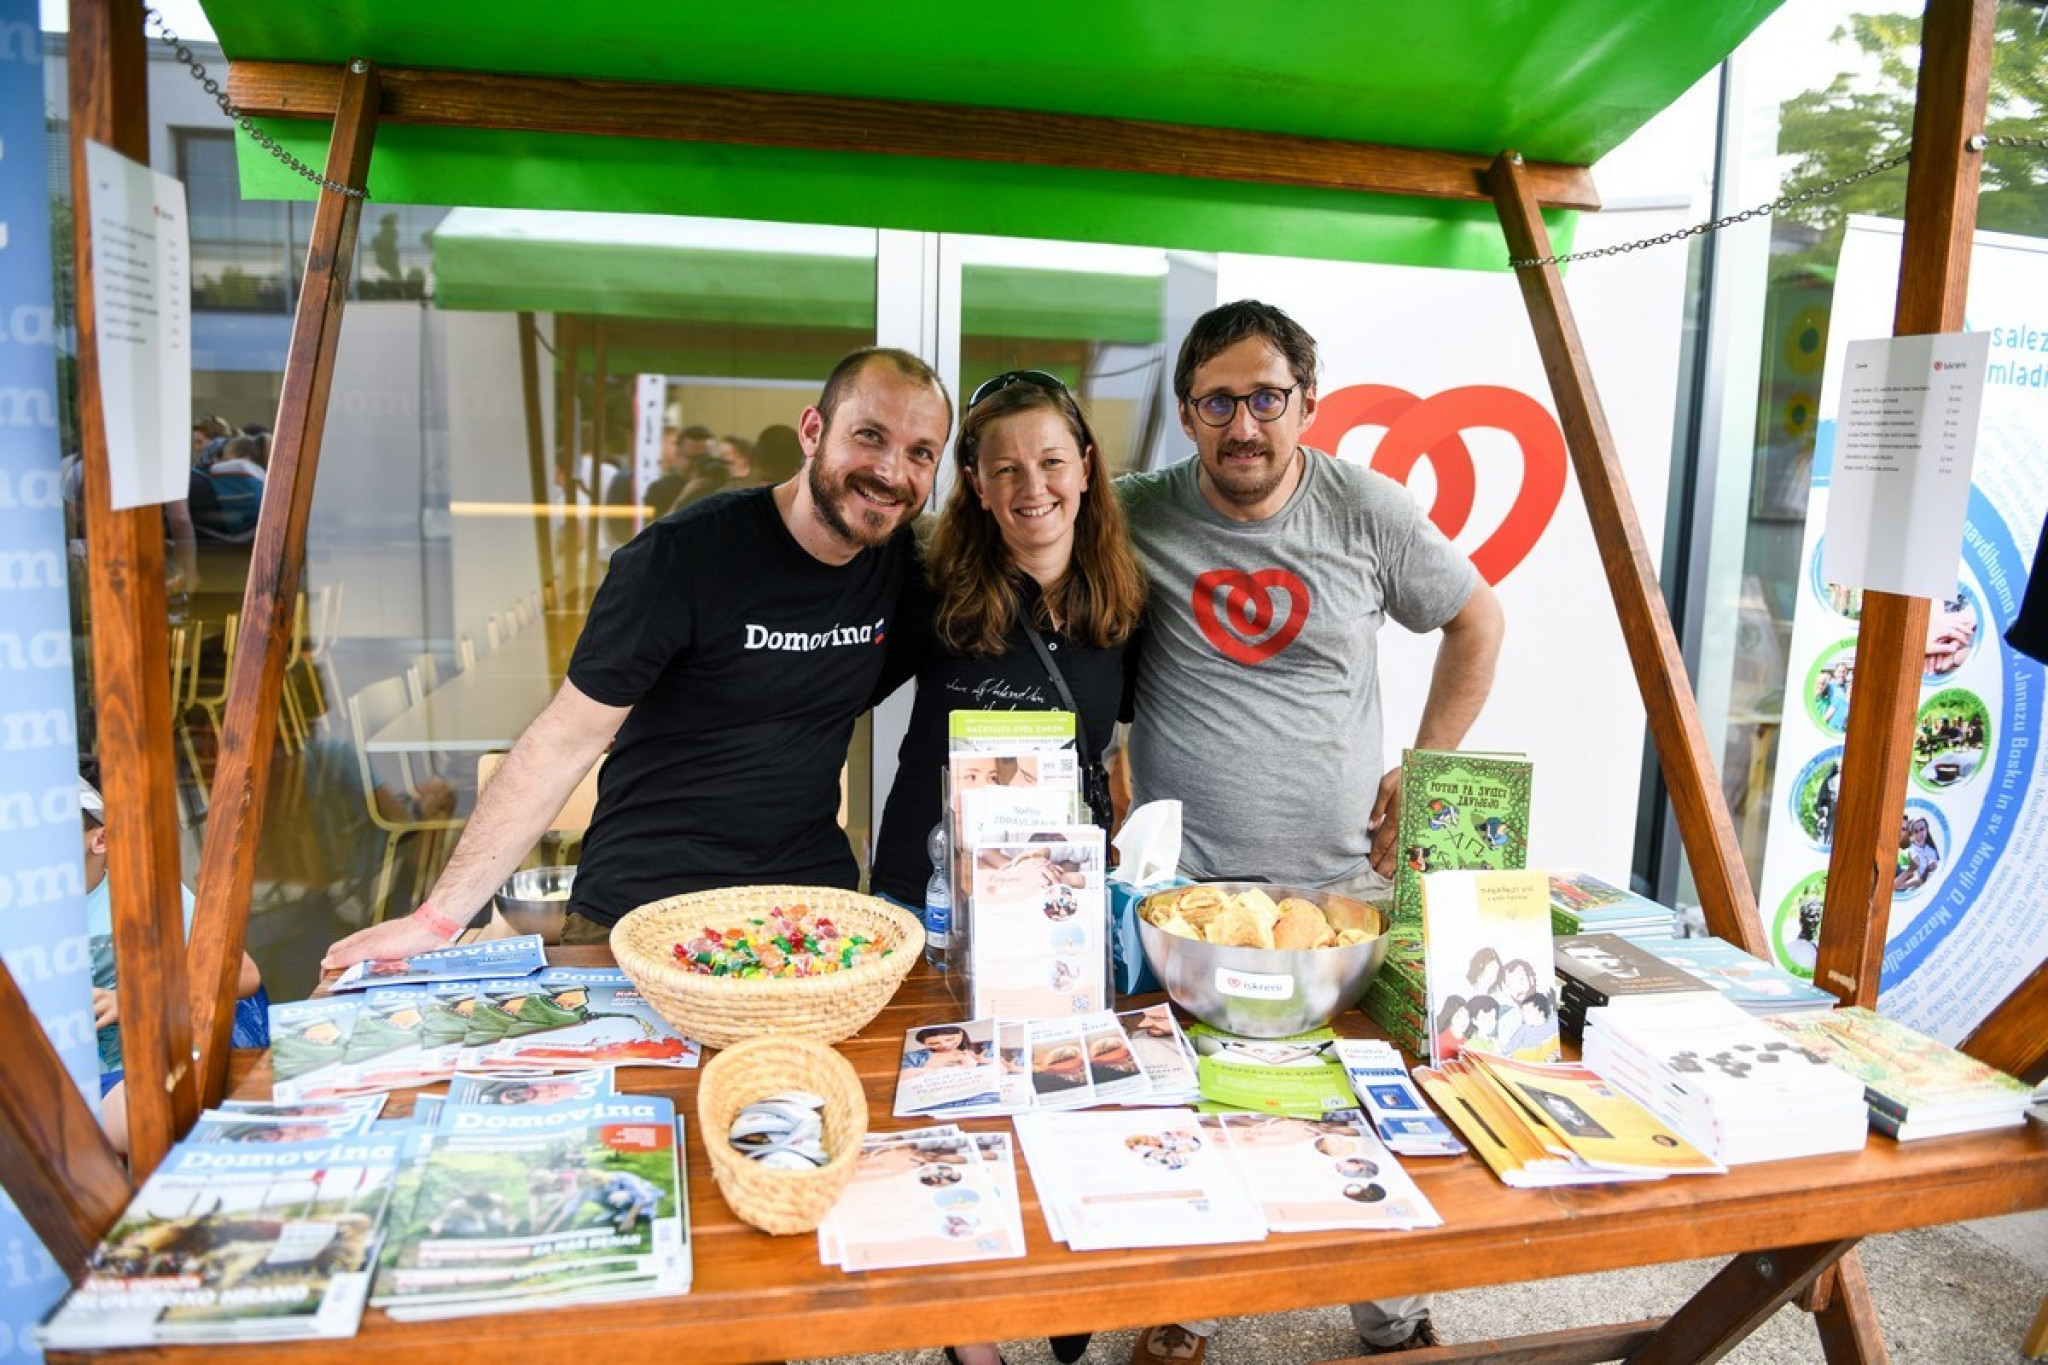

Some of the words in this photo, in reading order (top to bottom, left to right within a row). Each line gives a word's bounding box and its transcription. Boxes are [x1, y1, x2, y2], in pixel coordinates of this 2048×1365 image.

[745, 622, 872, 652] Domovina
[2013, 671, 2032, 731] Janezu
[2002, 736, 2029, 789] Bosku
[1995, 793, 2014, 810] in
[1243, 980, 1283, 993] iskreni
[455, 1102, 655, 1129] Domovina
[180, 1144, 396, 1170] Domovina
